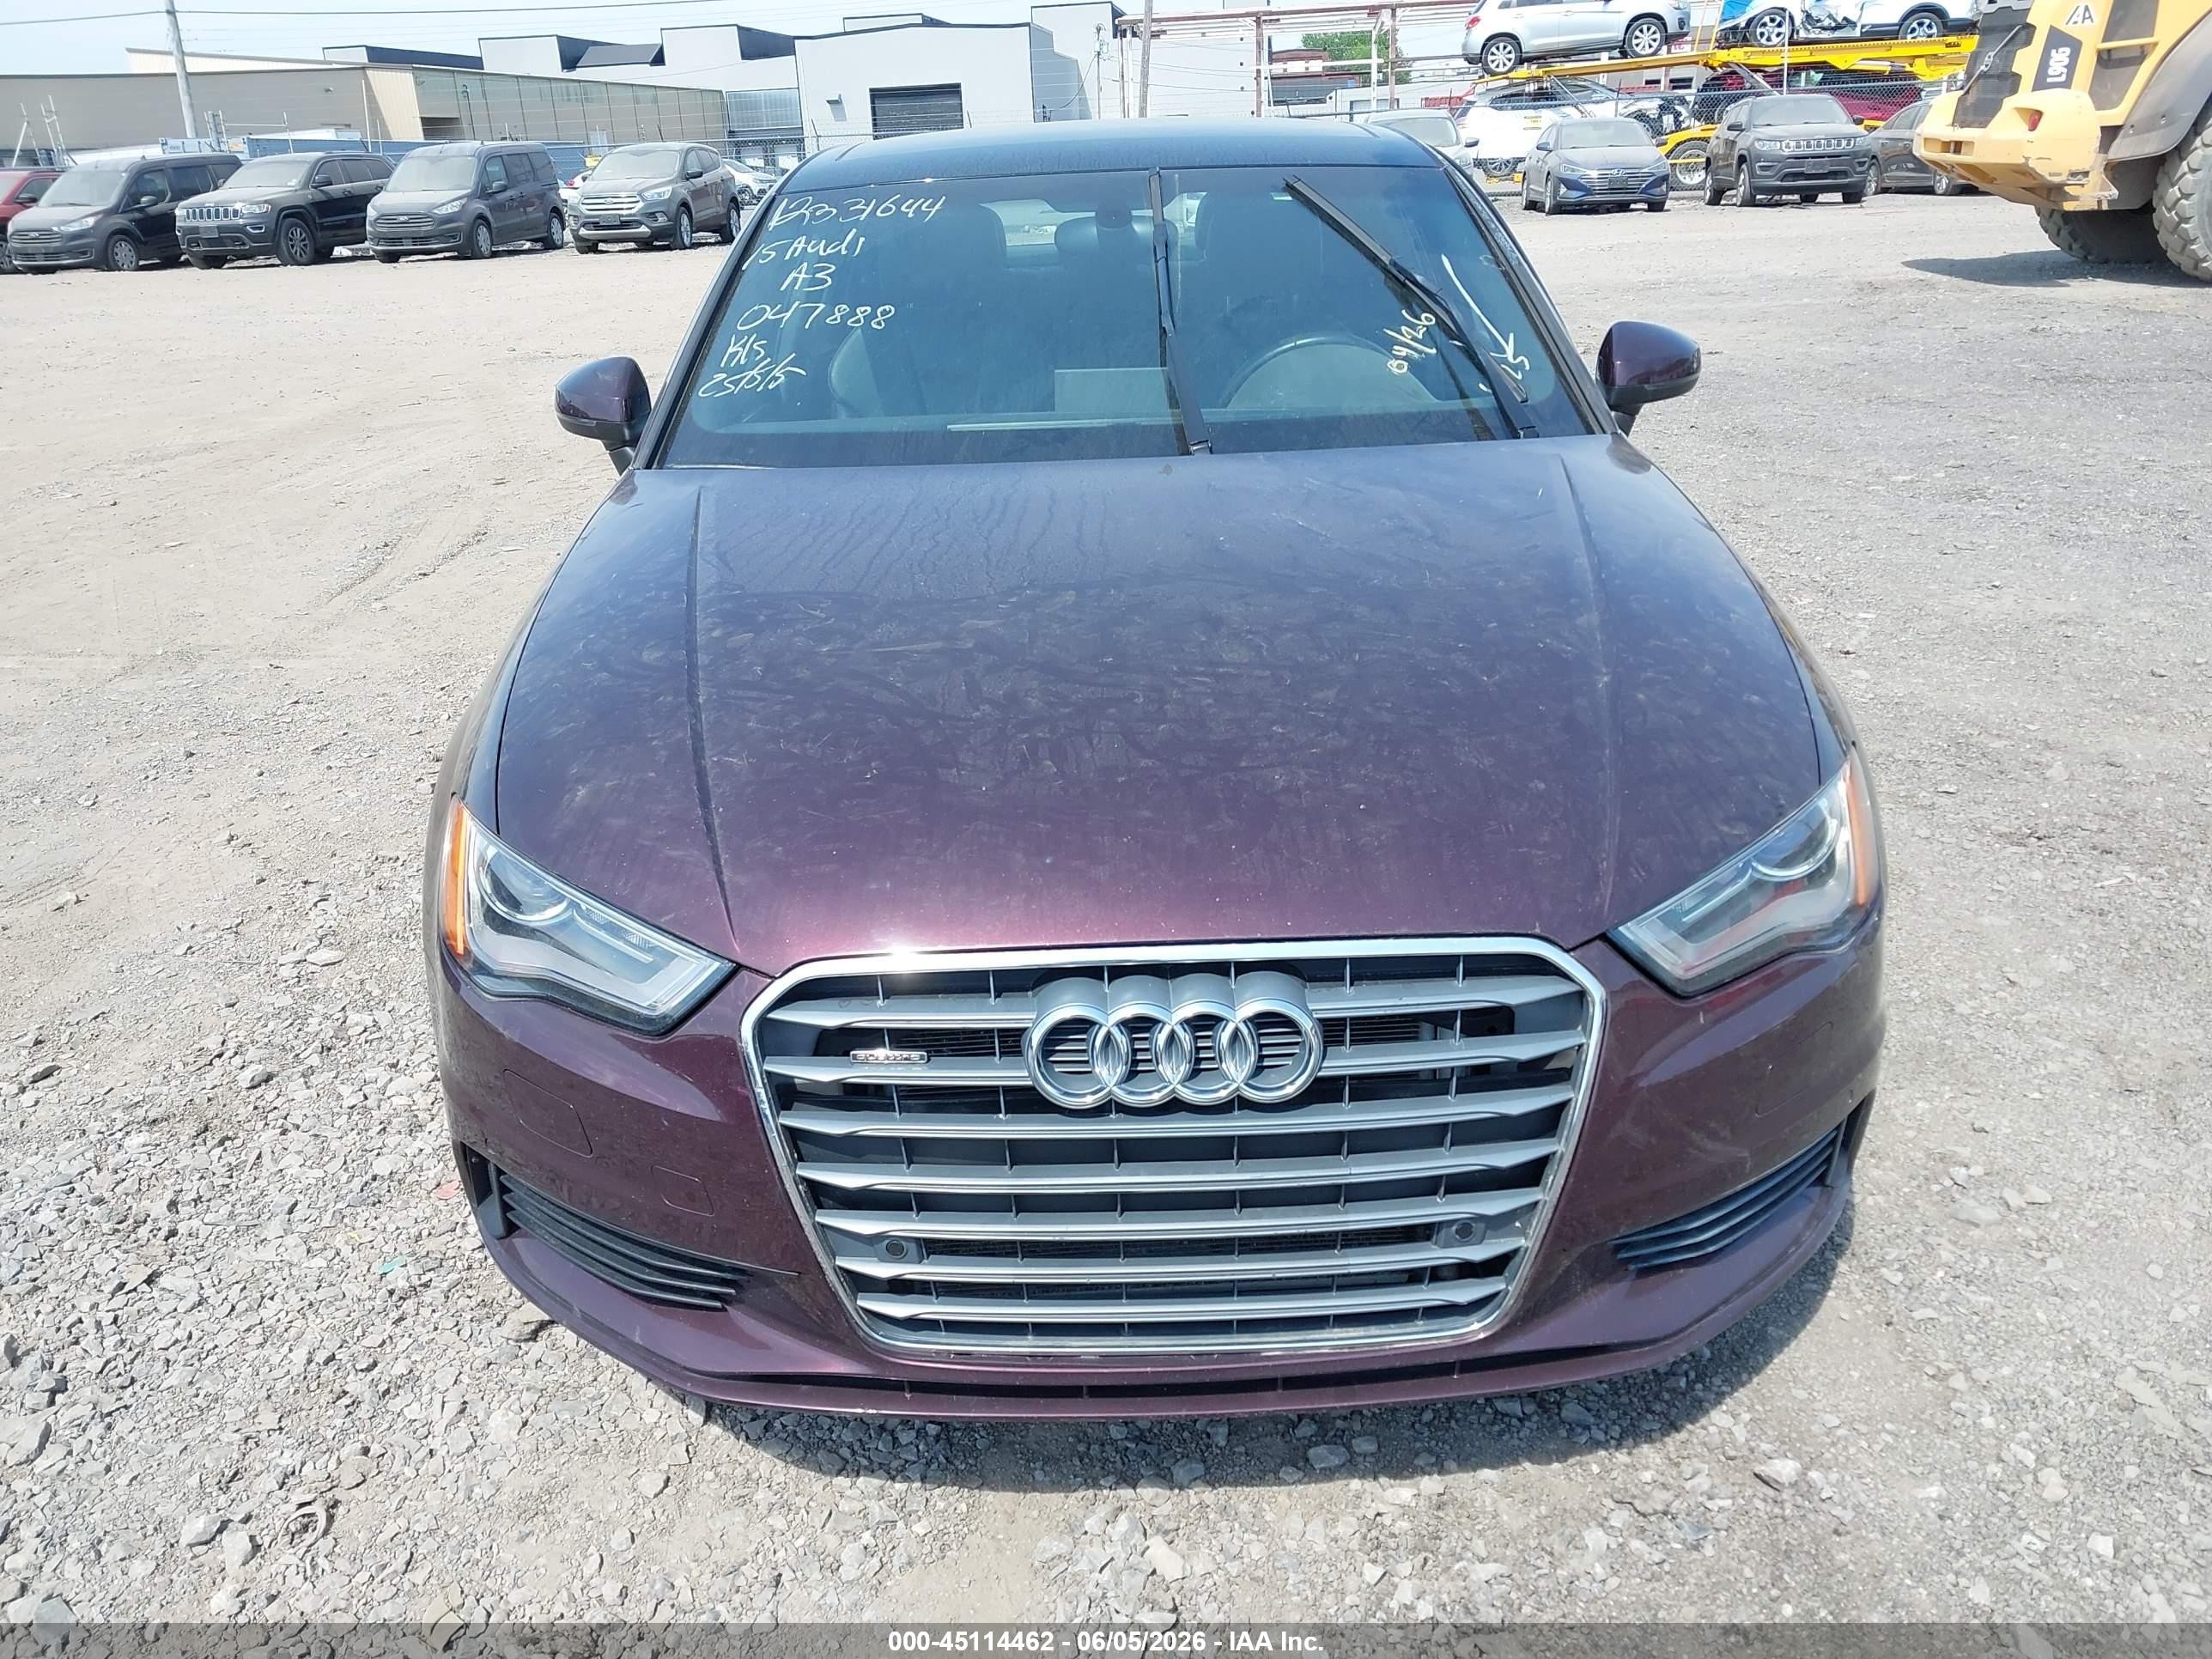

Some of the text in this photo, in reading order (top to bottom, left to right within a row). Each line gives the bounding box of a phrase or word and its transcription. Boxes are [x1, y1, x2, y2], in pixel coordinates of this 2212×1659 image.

[783, 228, 866, 261] Audi
[780, 261, 836, 291] A3
[736, 301, 896, 330] 047888
